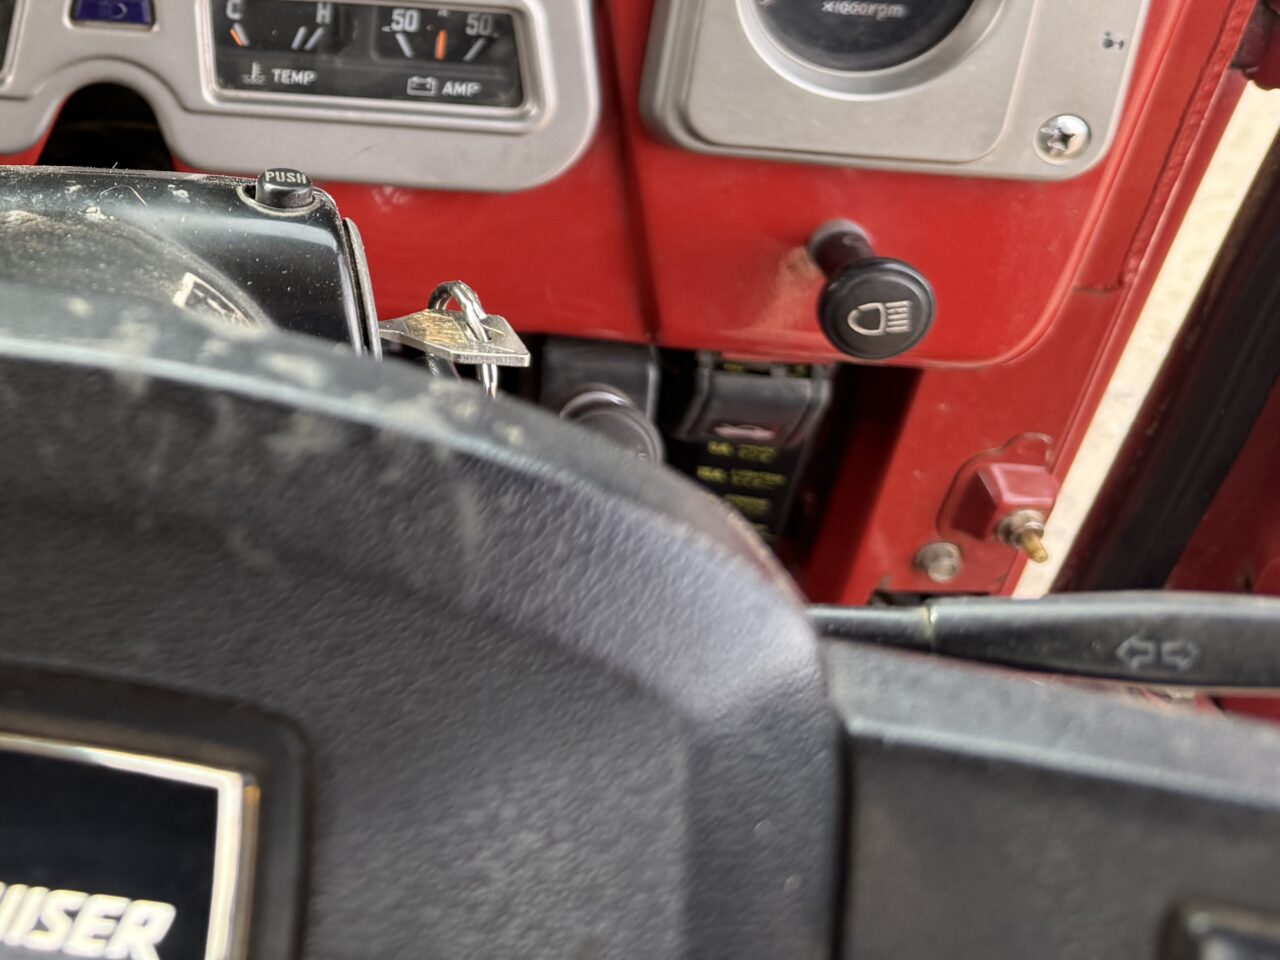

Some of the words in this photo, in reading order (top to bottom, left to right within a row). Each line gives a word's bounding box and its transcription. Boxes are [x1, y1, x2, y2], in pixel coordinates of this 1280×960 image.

[315, 3, 332, 24] H
[391, 8, 419, 33] 50
[465, 14, 494, 37] 50
[271, 67, 318, 86] TEMP
[442, 82, 482, 97] AMP
[264, 171, 307, 184] PUSH
